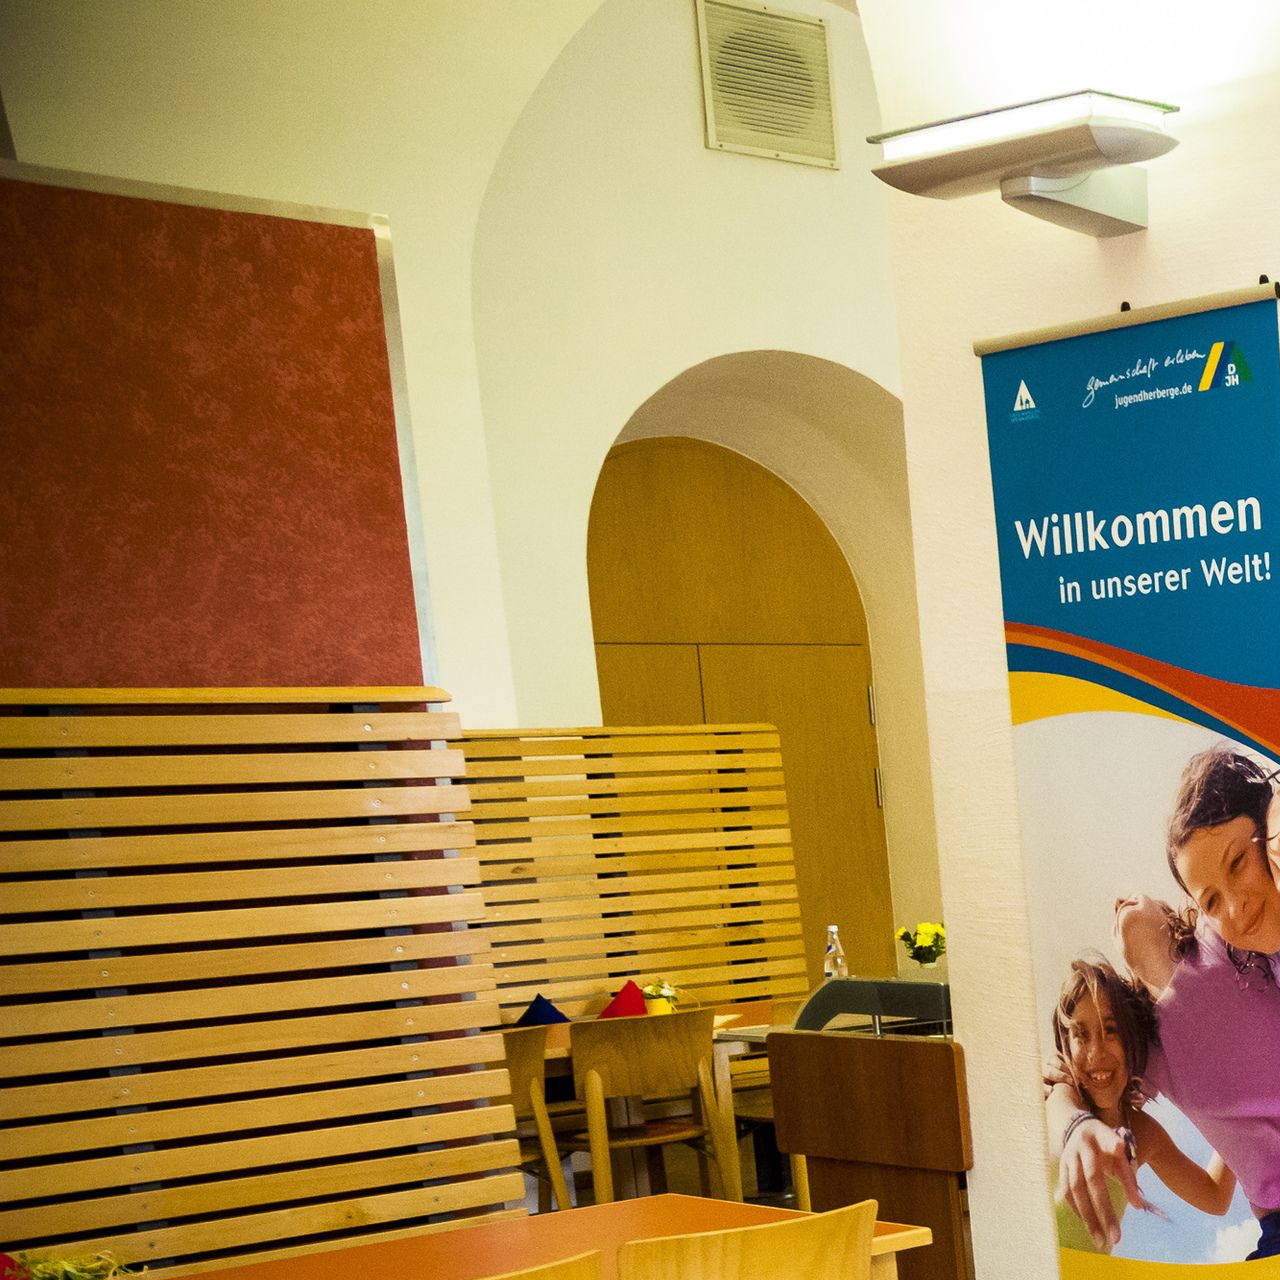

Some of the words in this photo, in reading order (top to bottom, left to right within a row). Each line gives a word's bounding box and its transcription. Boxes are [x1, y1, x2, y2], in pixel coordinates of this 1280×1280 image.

[1114, 382, 1193, 409] jugendherberge.de
[1014, 496, 1262, 559] Willkommen
[1059, 576, 1081, 604] in
[1091, 566, 1191, 600] unserer
[1200, 552, 1271, 587] Welt!
